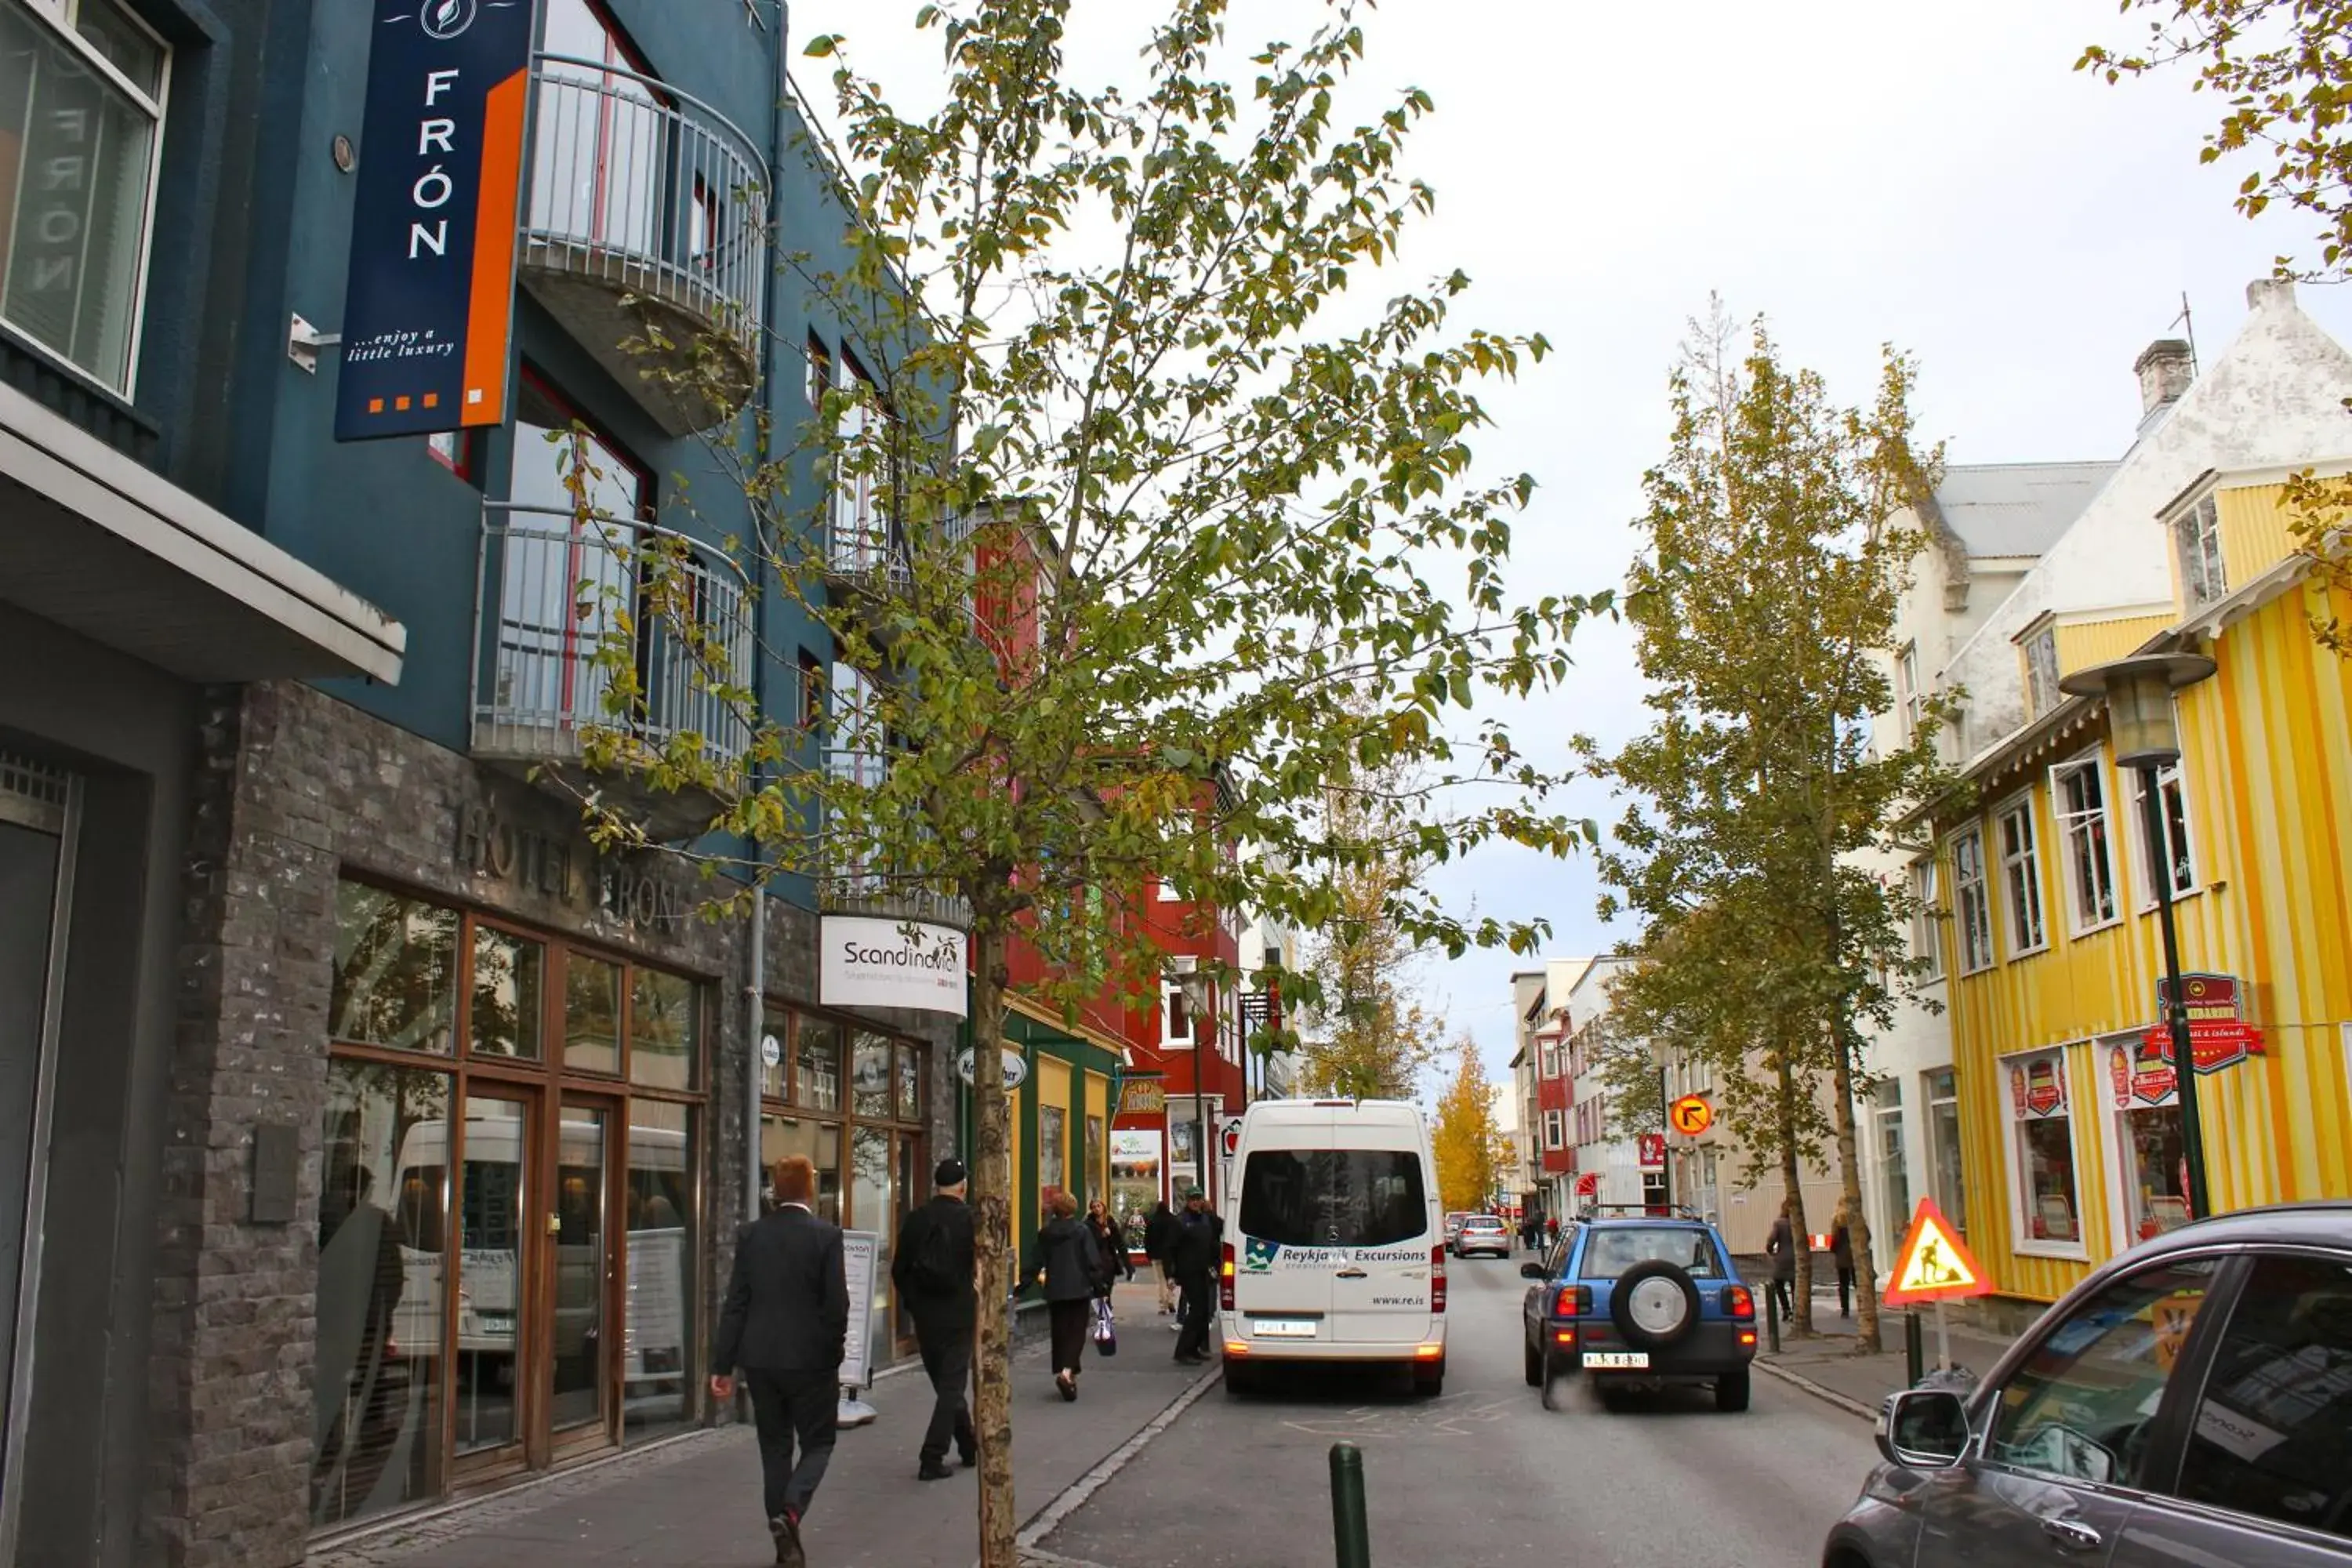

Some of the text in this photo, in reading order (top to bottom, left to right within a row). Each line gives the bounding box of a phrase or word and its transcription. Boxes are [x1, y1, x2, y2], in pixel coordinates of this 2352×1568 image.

[408, 67, 459, 260] FRÓN
[425, 329, 434, 339] a
[347, 342, 455, 361] little luxury
[1354, 1248, 1426, 1261] Excursions
[1372, 1294, 1425, 1305] www.re.is
